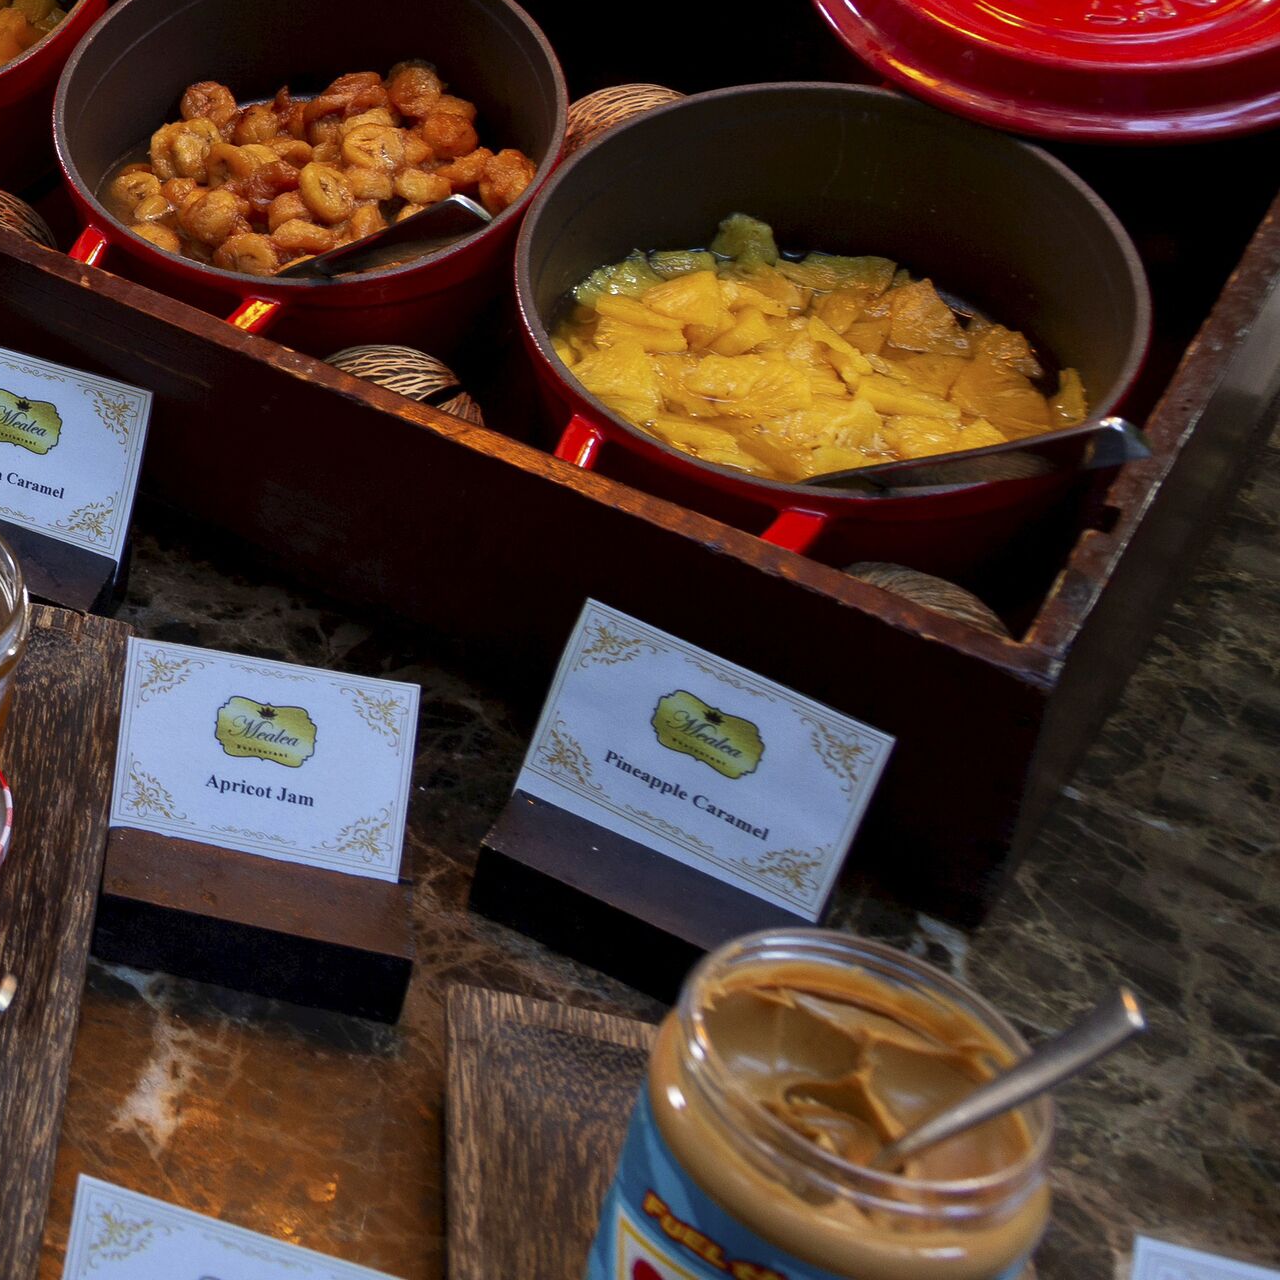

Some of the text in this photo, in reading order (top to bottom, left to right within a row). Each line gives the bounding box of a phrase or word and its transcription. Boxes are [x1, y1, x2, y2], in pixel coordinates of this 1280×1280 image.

[6, 472, 65, 500] Caramel
[228, 715, 299, 747] Mealea
[665, 710, 743, 759] Mealea
[205, 774, 314, 807] Apricot Jam
[604, 749, 770, 841] Pineapple Caramel
